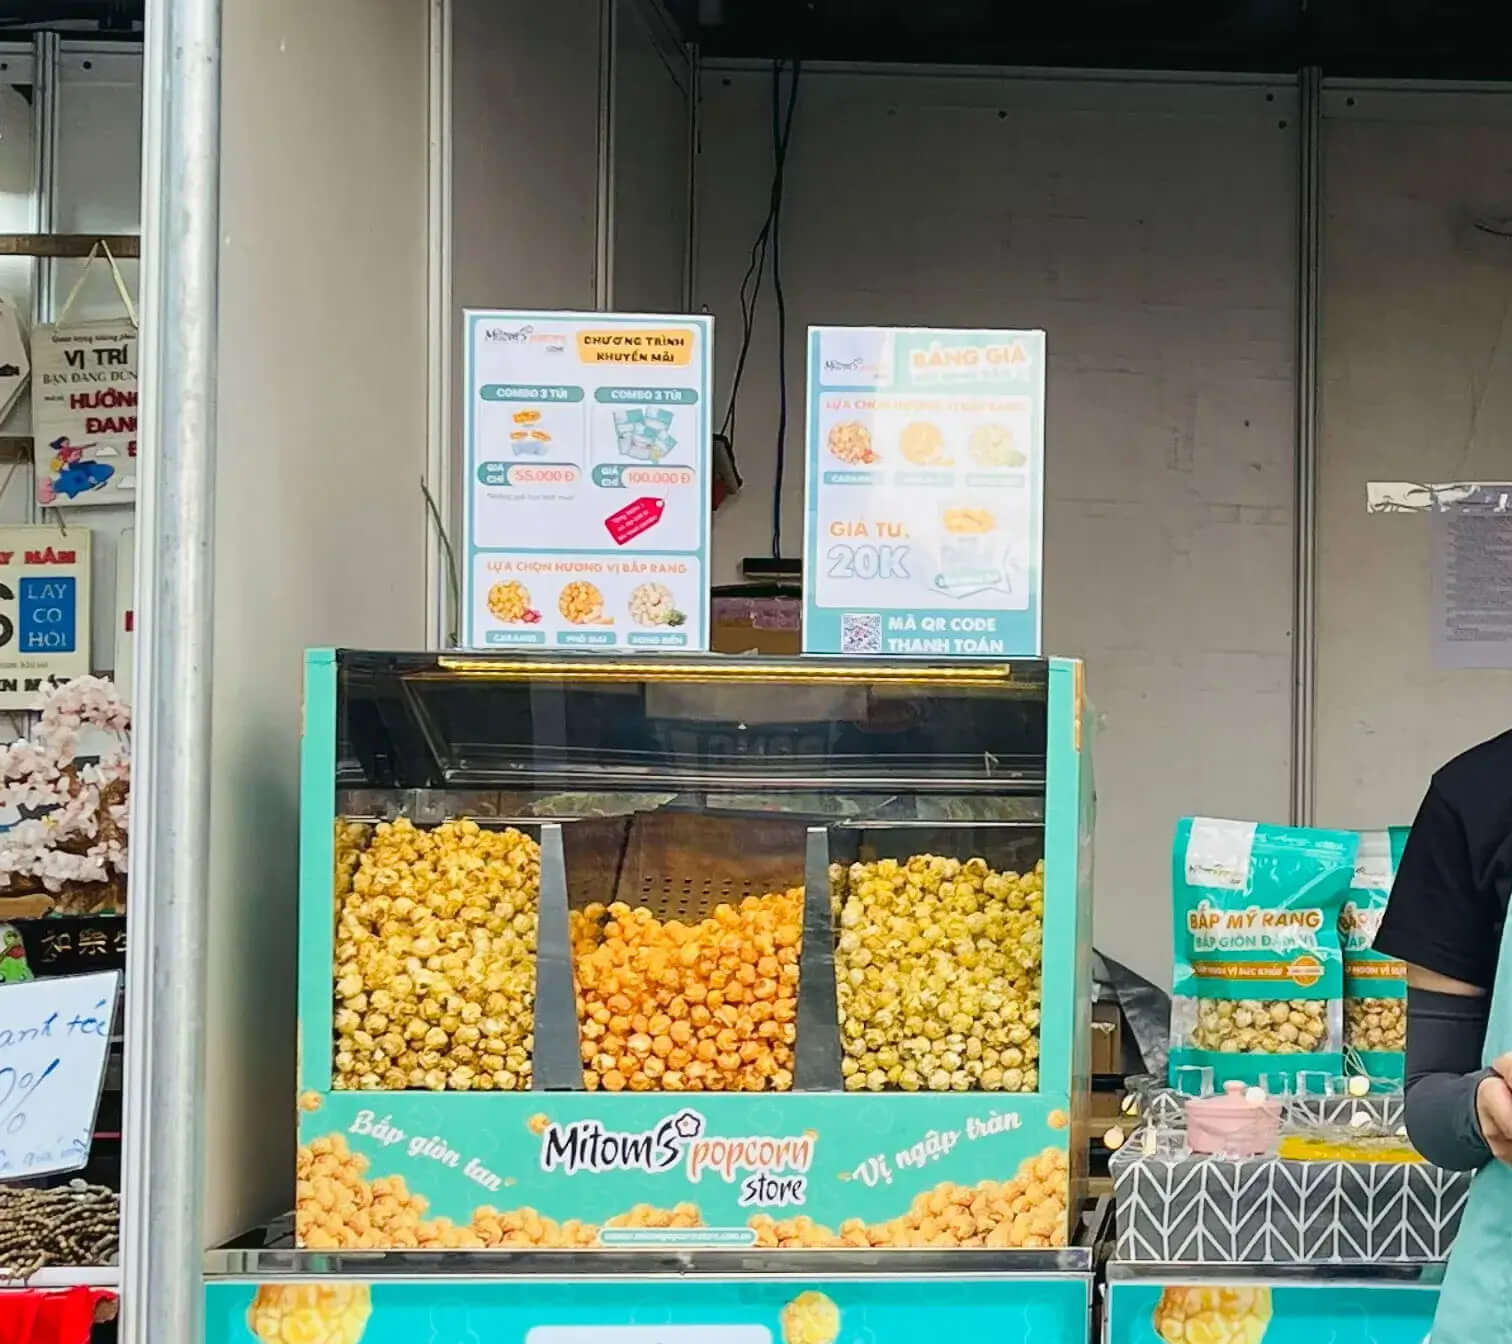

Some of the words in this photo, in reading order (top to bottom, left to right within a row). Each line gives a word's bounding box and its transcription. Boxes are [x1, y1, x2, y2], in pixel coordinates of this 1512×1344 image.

[827, 544, 911, 580] 20K
[921, 616, 946, 631] QR
[950, 616, 996, 631] CODE
[1261, 911, 1322, 928] RANG
[966, 1109, 1023, 1141] tràn
[545, 1119, 681, 1170] Mitom's
[690, 1137, 810, 1178] popcorn
[463, 1157, 503, 1192] tan
[744, 1172, 803, 1202] store
